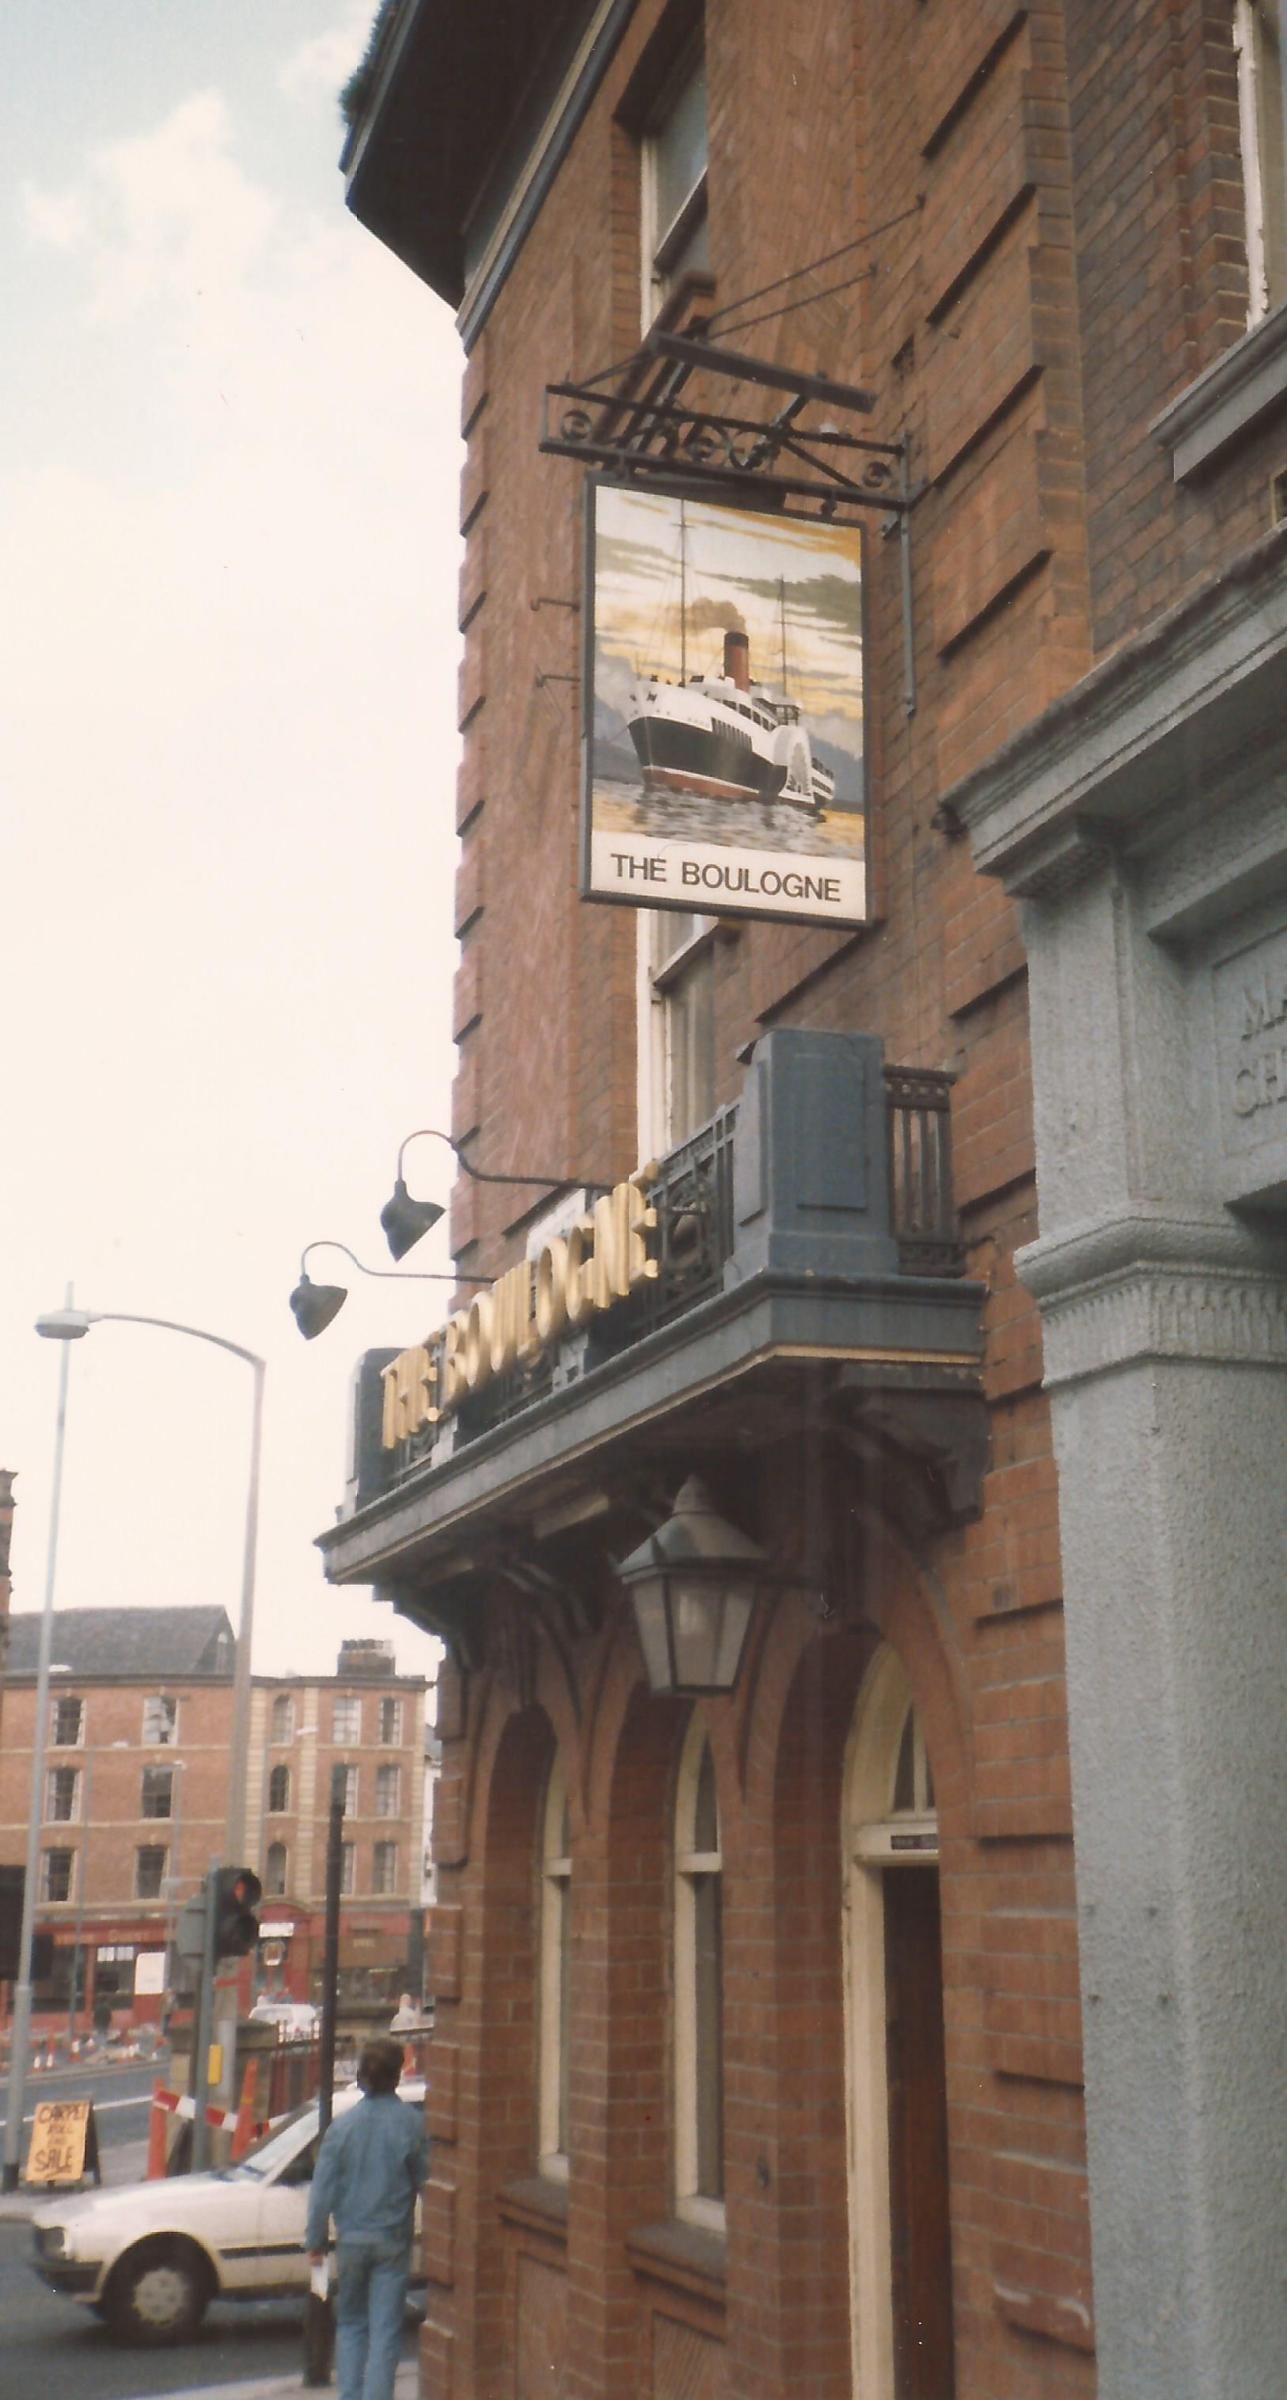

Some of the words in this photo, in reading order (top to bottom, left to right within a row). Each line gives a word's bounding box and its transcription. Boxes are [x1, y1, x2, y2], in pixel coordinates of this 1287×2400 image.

[611, 853, 667, 882] THE
[682, 862, 841, 902] BOULOGNE
[379, 1343, 439, 1449] THE
[34, 2146, 74, 2173] SALE
